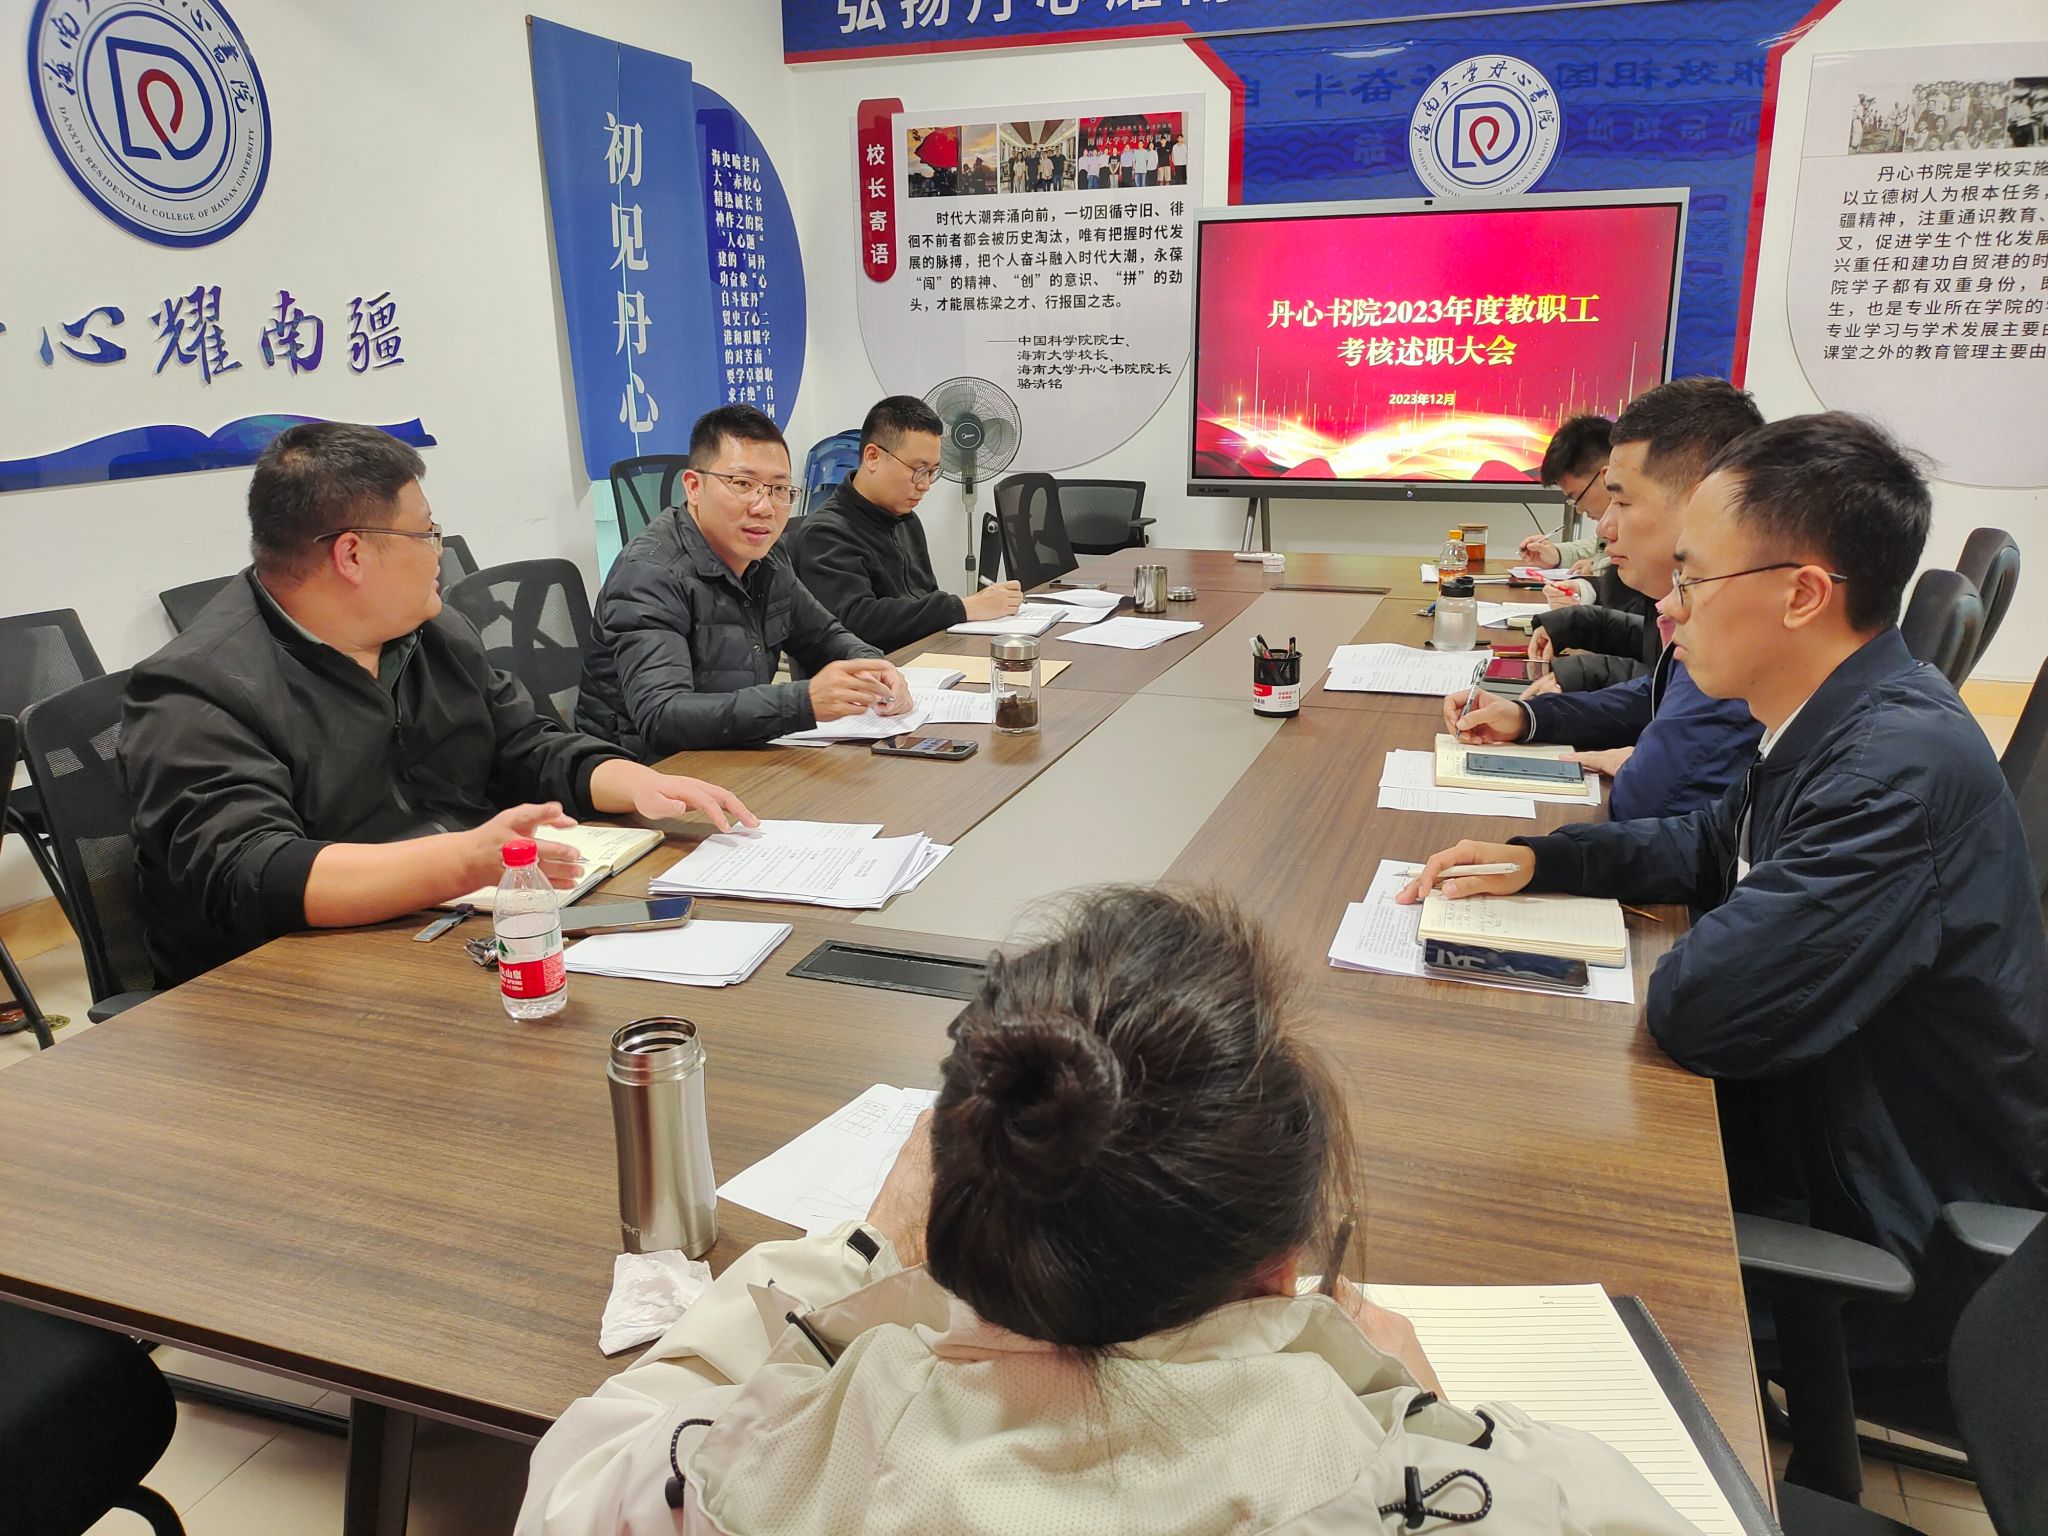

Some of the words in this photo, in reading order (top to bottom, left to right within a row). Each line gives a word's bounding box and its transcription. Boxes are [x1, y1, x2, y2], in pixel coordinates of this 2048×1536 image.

[59, 106, 86, 154] DANXIN
[85, 156, 148, 213] RESIDENTIAL
[152, 208, 196, 221] COLLEGE
[197, 210, 209, 219] OF
[211, 187, 238, 214] HAINAN
[235, 128, 255, 188] UNIVERSITY
[866, 143, 889, 265] 校长寄语
[936, 201, 1184, 226] 时代大潮奔涌向前，一切因循守旧、徘
[1839, 207, 2045, 230] 疆精神，注重通识教育、
[908, 224, 1184, 248] 徊不前者都会被历史淘汰，唯有把握时代发
[909, 246, 1184, 270] 展的脉搏，把个人奋斗融入时代大潮，永葆
[604, 111, 659, 433] 初见丹心
[910, 293, 1122, 313] 头，才能展栋梁之才、行报国之志。
[1267, 294, 1601, 329] 丹心书院2023年度教职工
[1827, 298, 2048, 318] 生，也是专业所在学院的
[0, 284, 404, 386] 心耀南疆
[1017, 350, 1115, 363] 海南大学校长、
[1336, 335, 1517, 367] 考核述职大会
[1823, 342, 2047, 361] 课堂之外的教育管理主要由
[1016, 363, 1172, 376] 海南大学丹心书院院长
[1017, 377, 1063, 390] 骆清铭
[1388, 393, 1456, 406] 2023年12月
